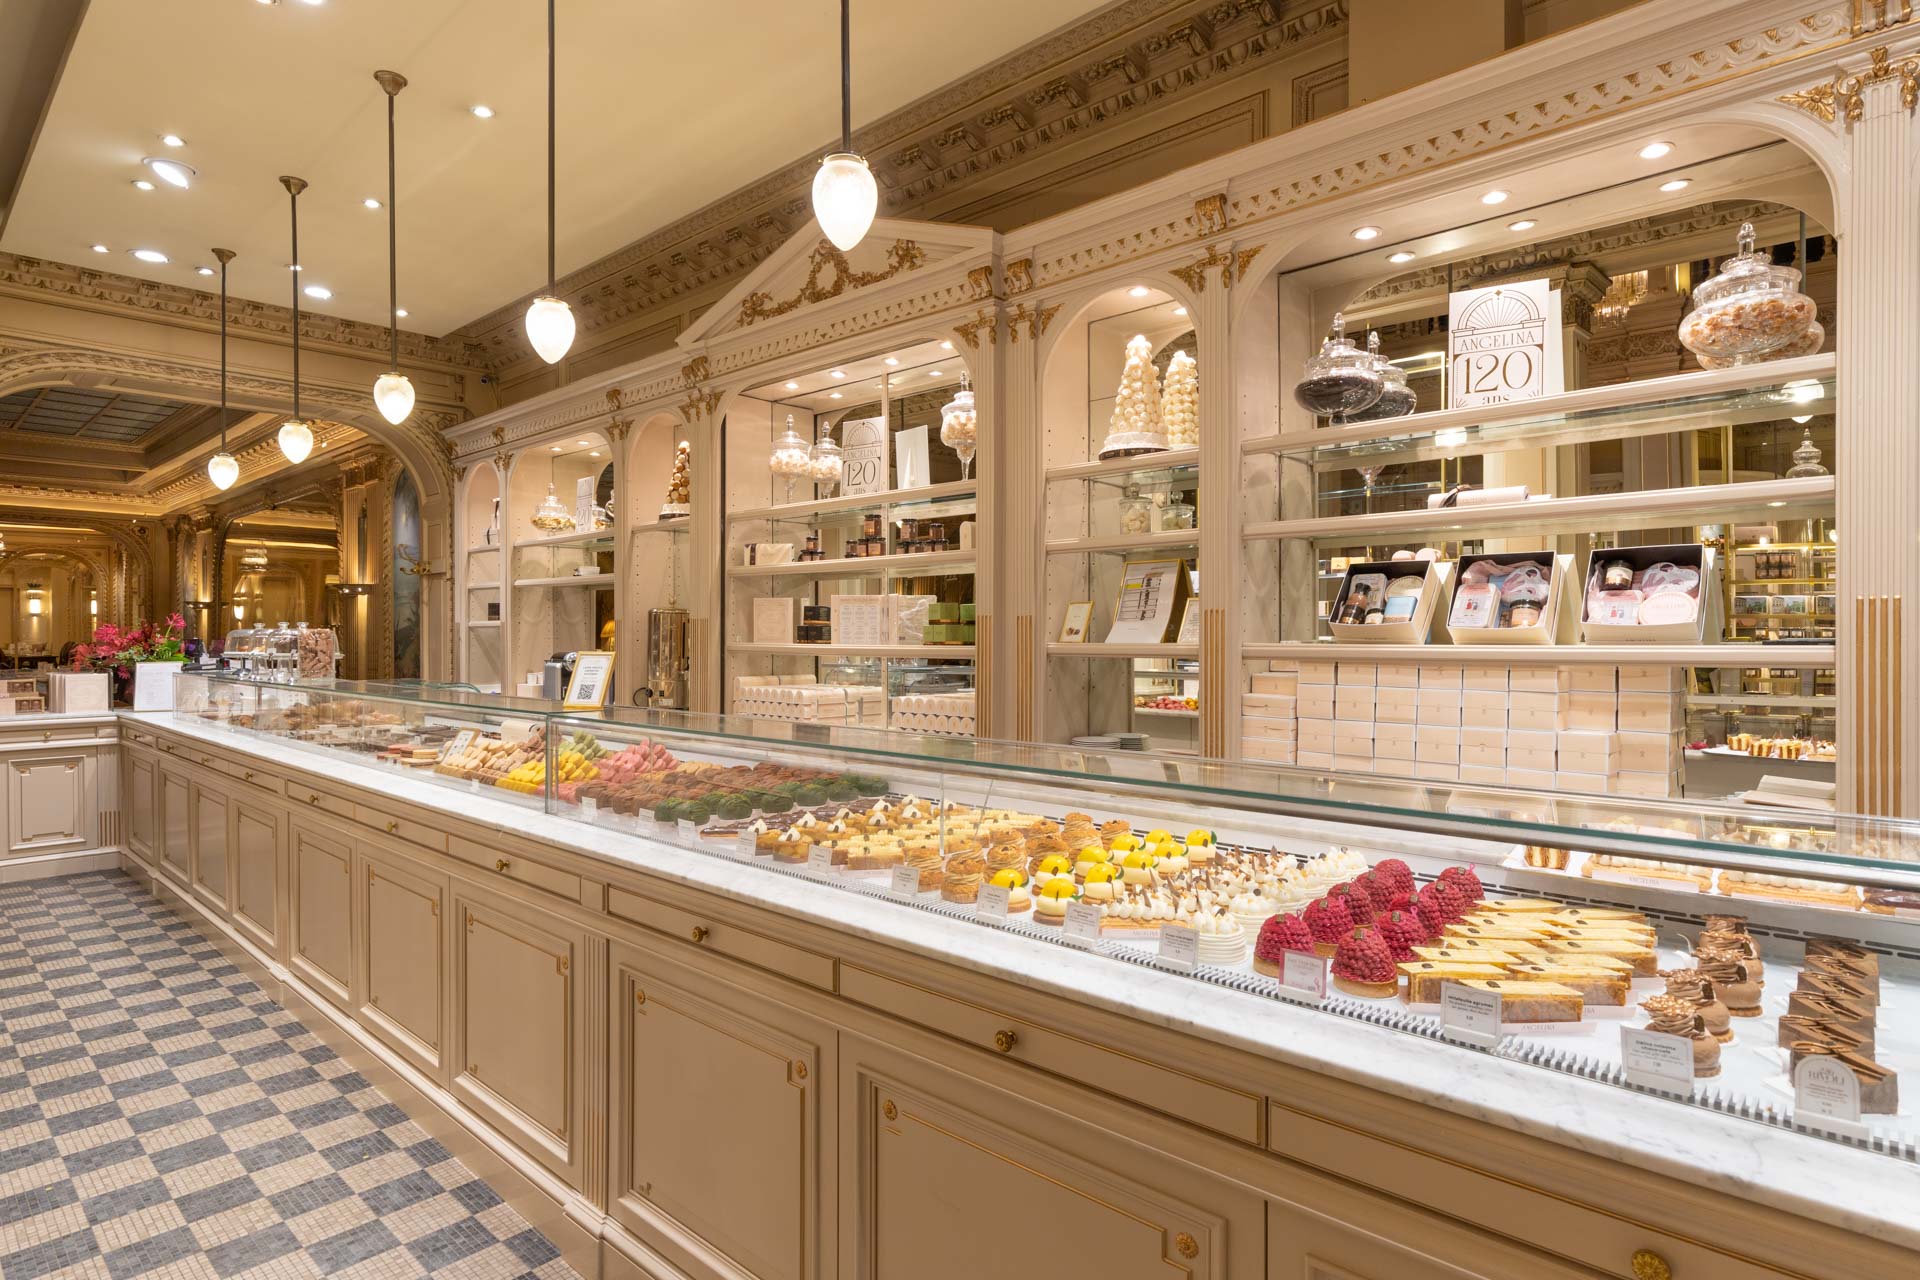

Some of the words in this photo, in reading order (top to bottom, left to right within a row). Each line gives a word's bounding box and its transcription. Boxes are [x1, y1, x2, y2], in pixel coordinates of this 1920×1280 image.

[1460, 331, 1535, 351] ANGELINA
[1464, 350, 1532, 394] 120
[847, 448, 878, 459] ANGELINA
[847, 460, 876, 486] 120
[1521, 1023, 1556, 1033] ANGELINA
